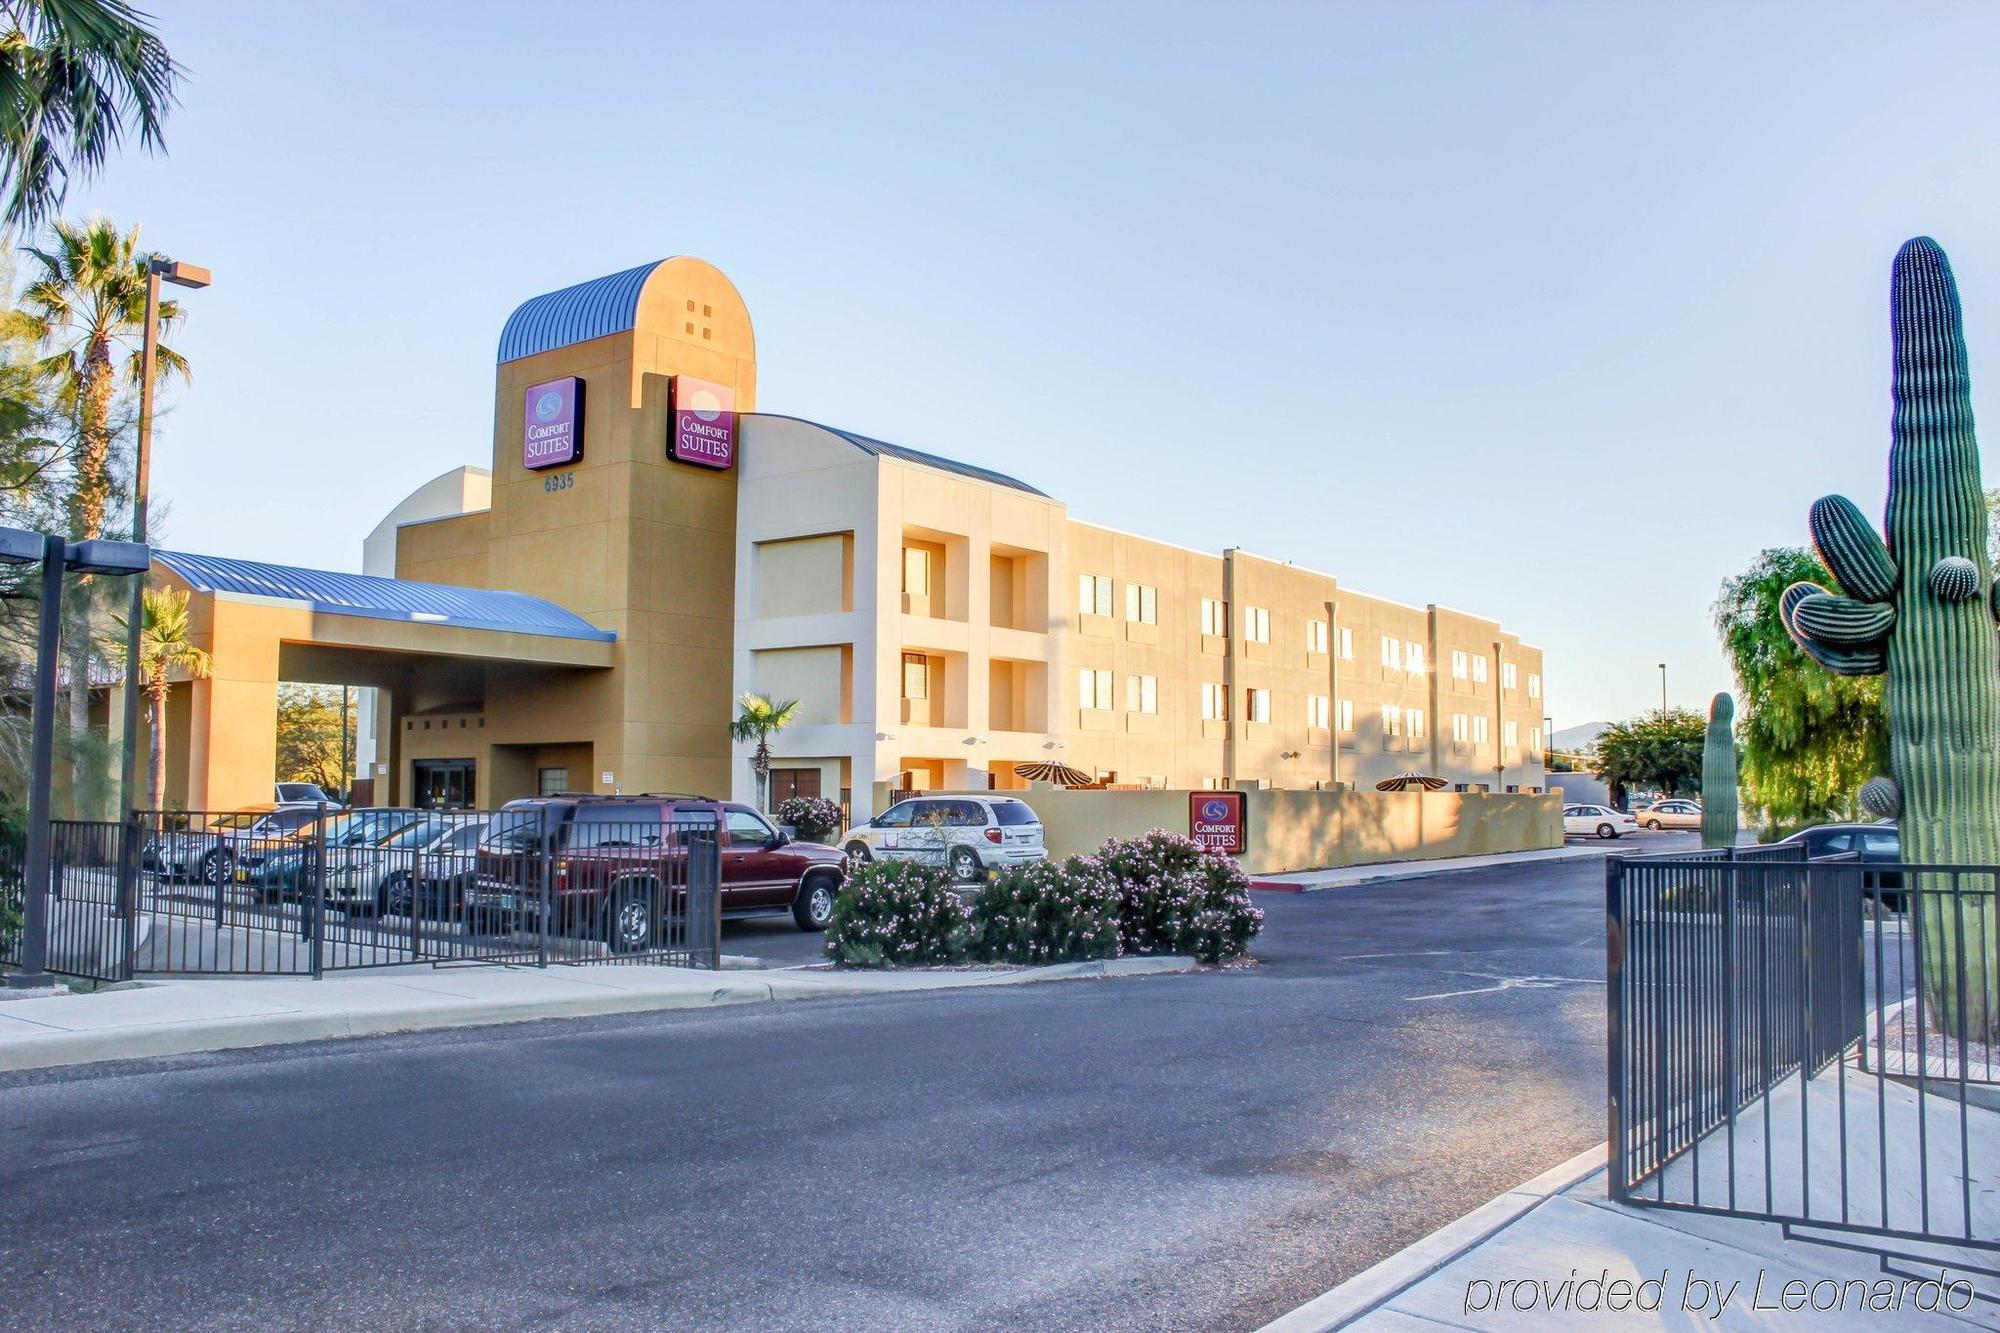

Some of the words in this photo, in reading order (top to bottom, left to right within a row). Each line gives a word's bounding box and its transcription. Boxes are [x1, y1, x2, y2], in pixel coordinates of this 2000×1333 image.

[528, 422, 570, 440] COMFORT
[681, 416, 729, 440] COMFORT
[528, 436, 569, 457] SUITES
[681, 434, 729, 458] SUITES
[544, 473, 575, 492] 6935
[1194, 821, 1236, 832] COMFORT
[1195, 834, 1236, 846] SUITES
